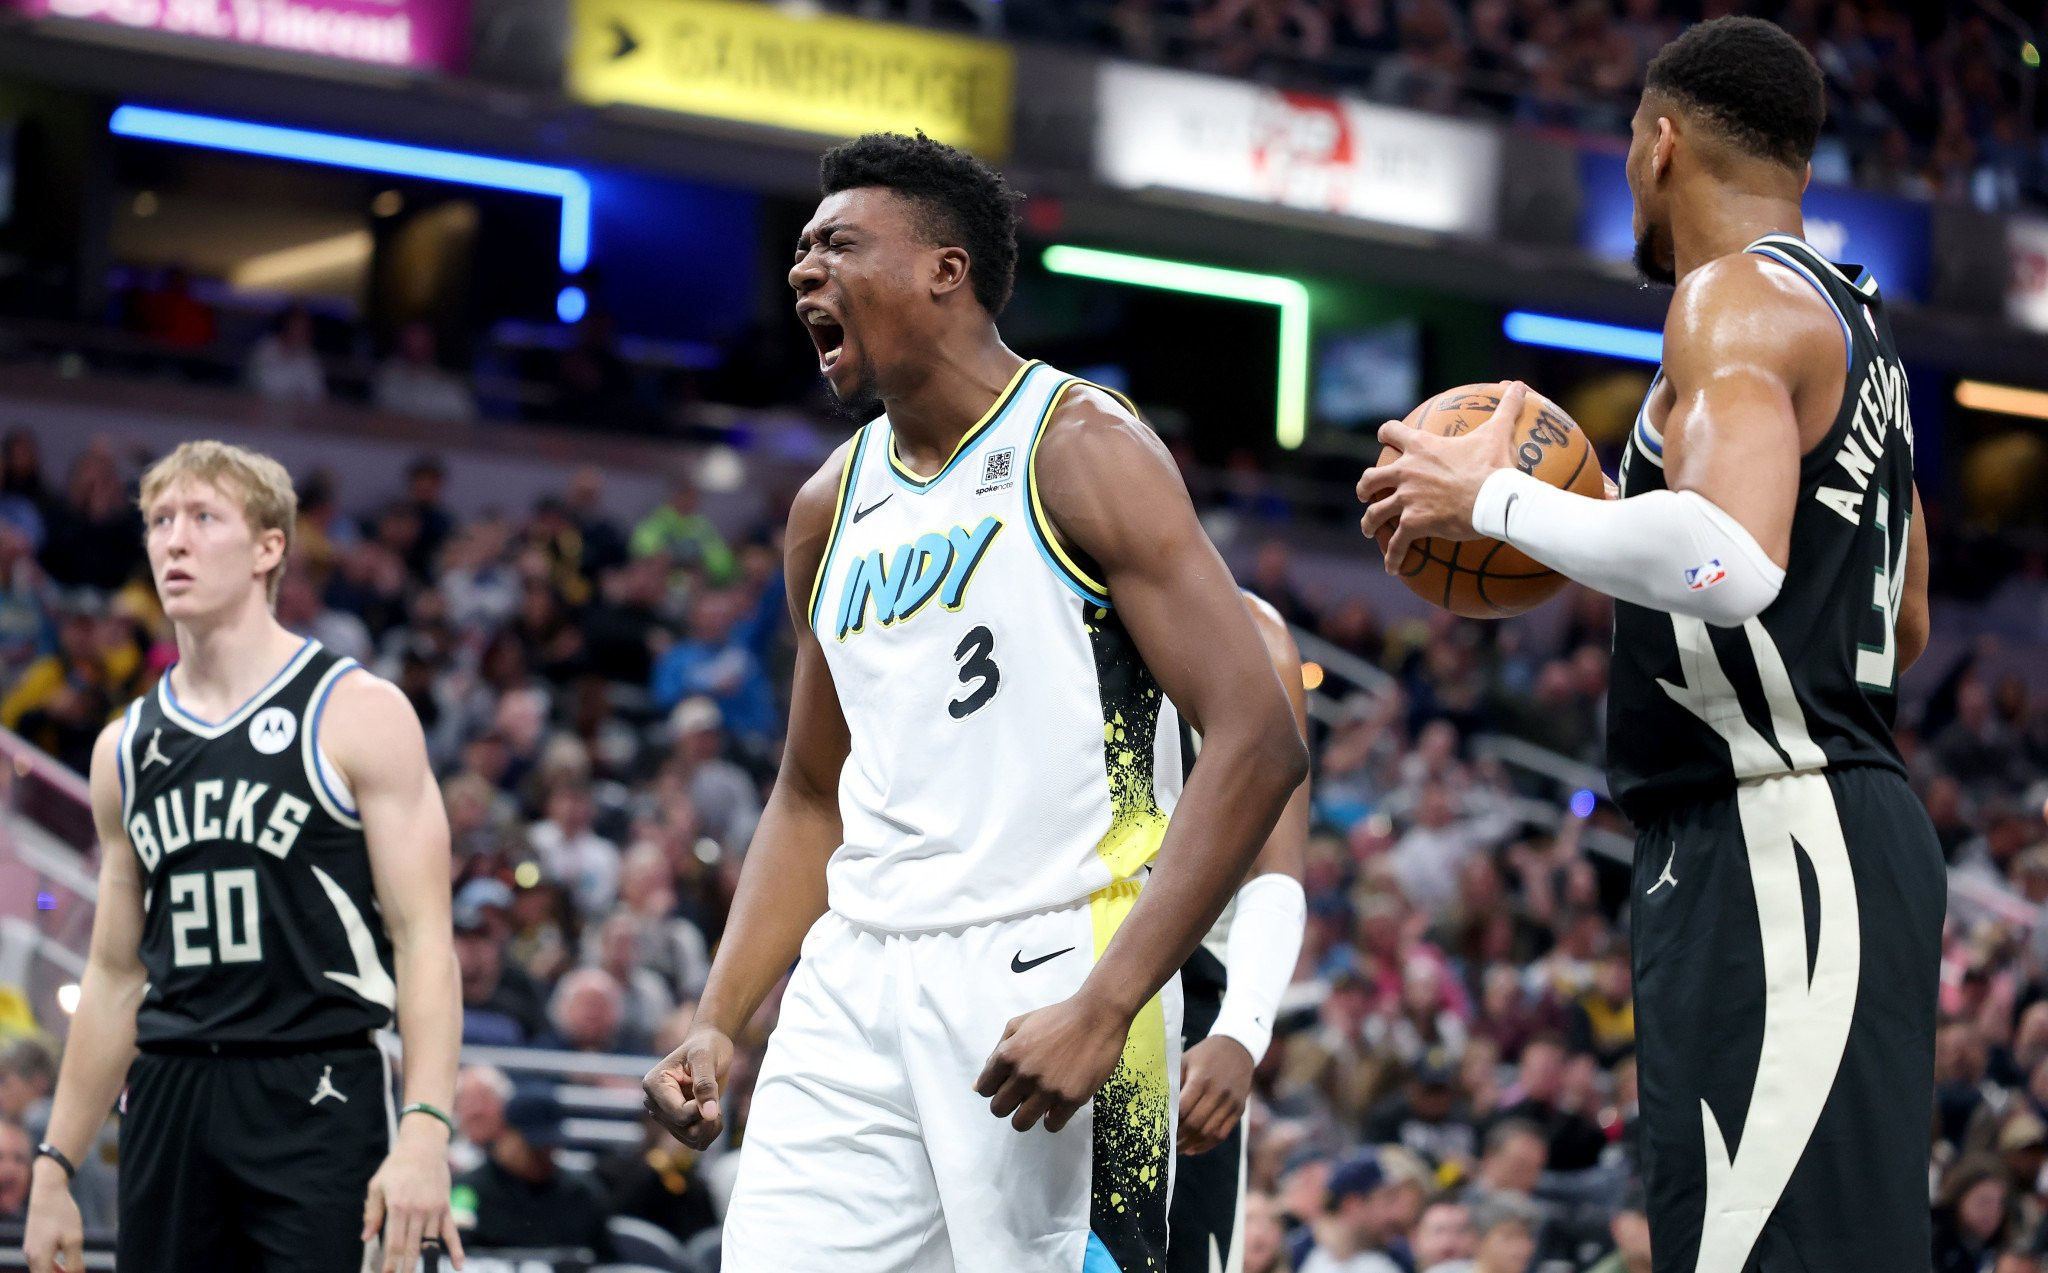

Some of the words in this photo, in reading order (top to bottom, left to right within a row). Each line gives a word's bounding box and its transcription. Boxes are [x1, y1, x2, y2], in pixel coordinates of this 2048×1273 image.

[976, 482, 1014, 496] spokenote
[836, 515, 1006, 643] INDY
[948, 624, 1001, 720] 3
[129, 779, 312, 874] BUCKS
[169, 868, 263, 967] 20
